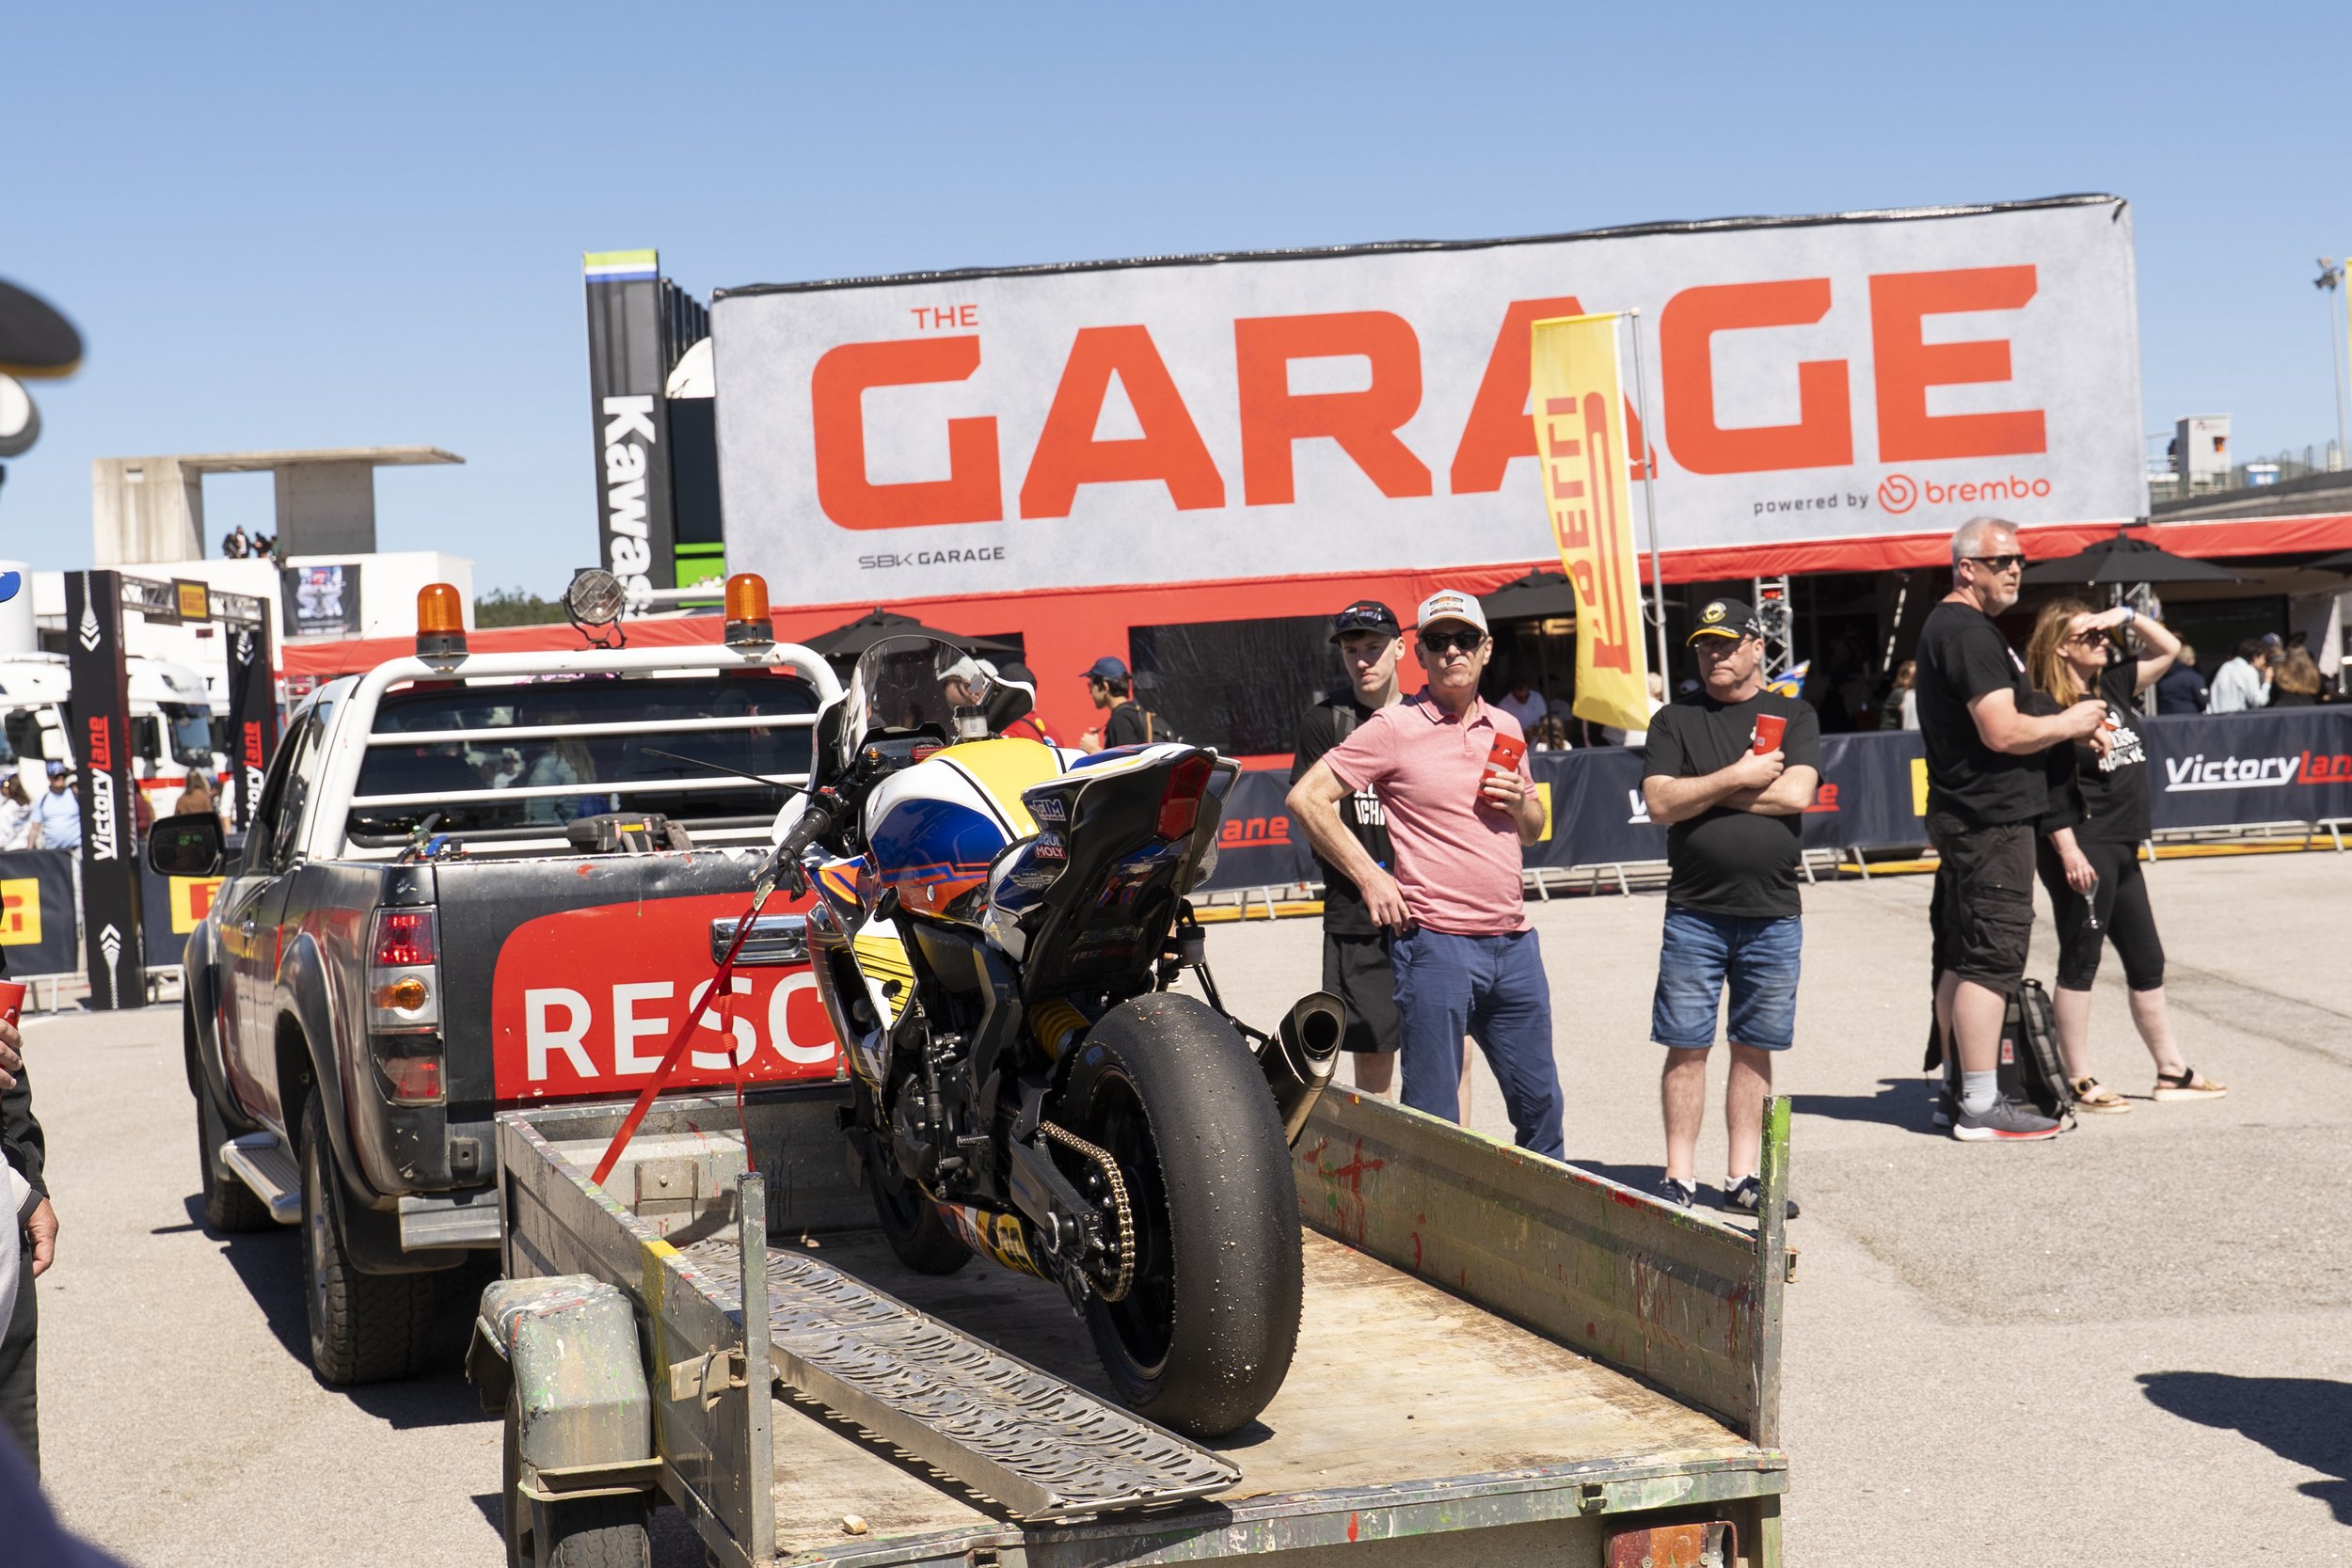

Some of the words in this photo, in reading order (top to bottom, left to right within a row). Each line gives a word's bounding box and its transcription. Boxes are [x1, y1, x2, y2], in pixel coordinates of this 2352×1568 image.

[910, 304, 978, 330] THE
[811, 264, 2045, 531] GARAGE
[602, 395, 657, 621] Kawas
[1754, 493, 1838, 515] powered
[1847, 493, 1868, 510] by
[1925, 474, 2051, 504] brembo
[1546, 391, 1632, 674] PRELLI
[858, 552, 914, 570] SBK
[917, 546, 1006, 565] GARAGE
[1036, 847, 1064, 858] MOLY
